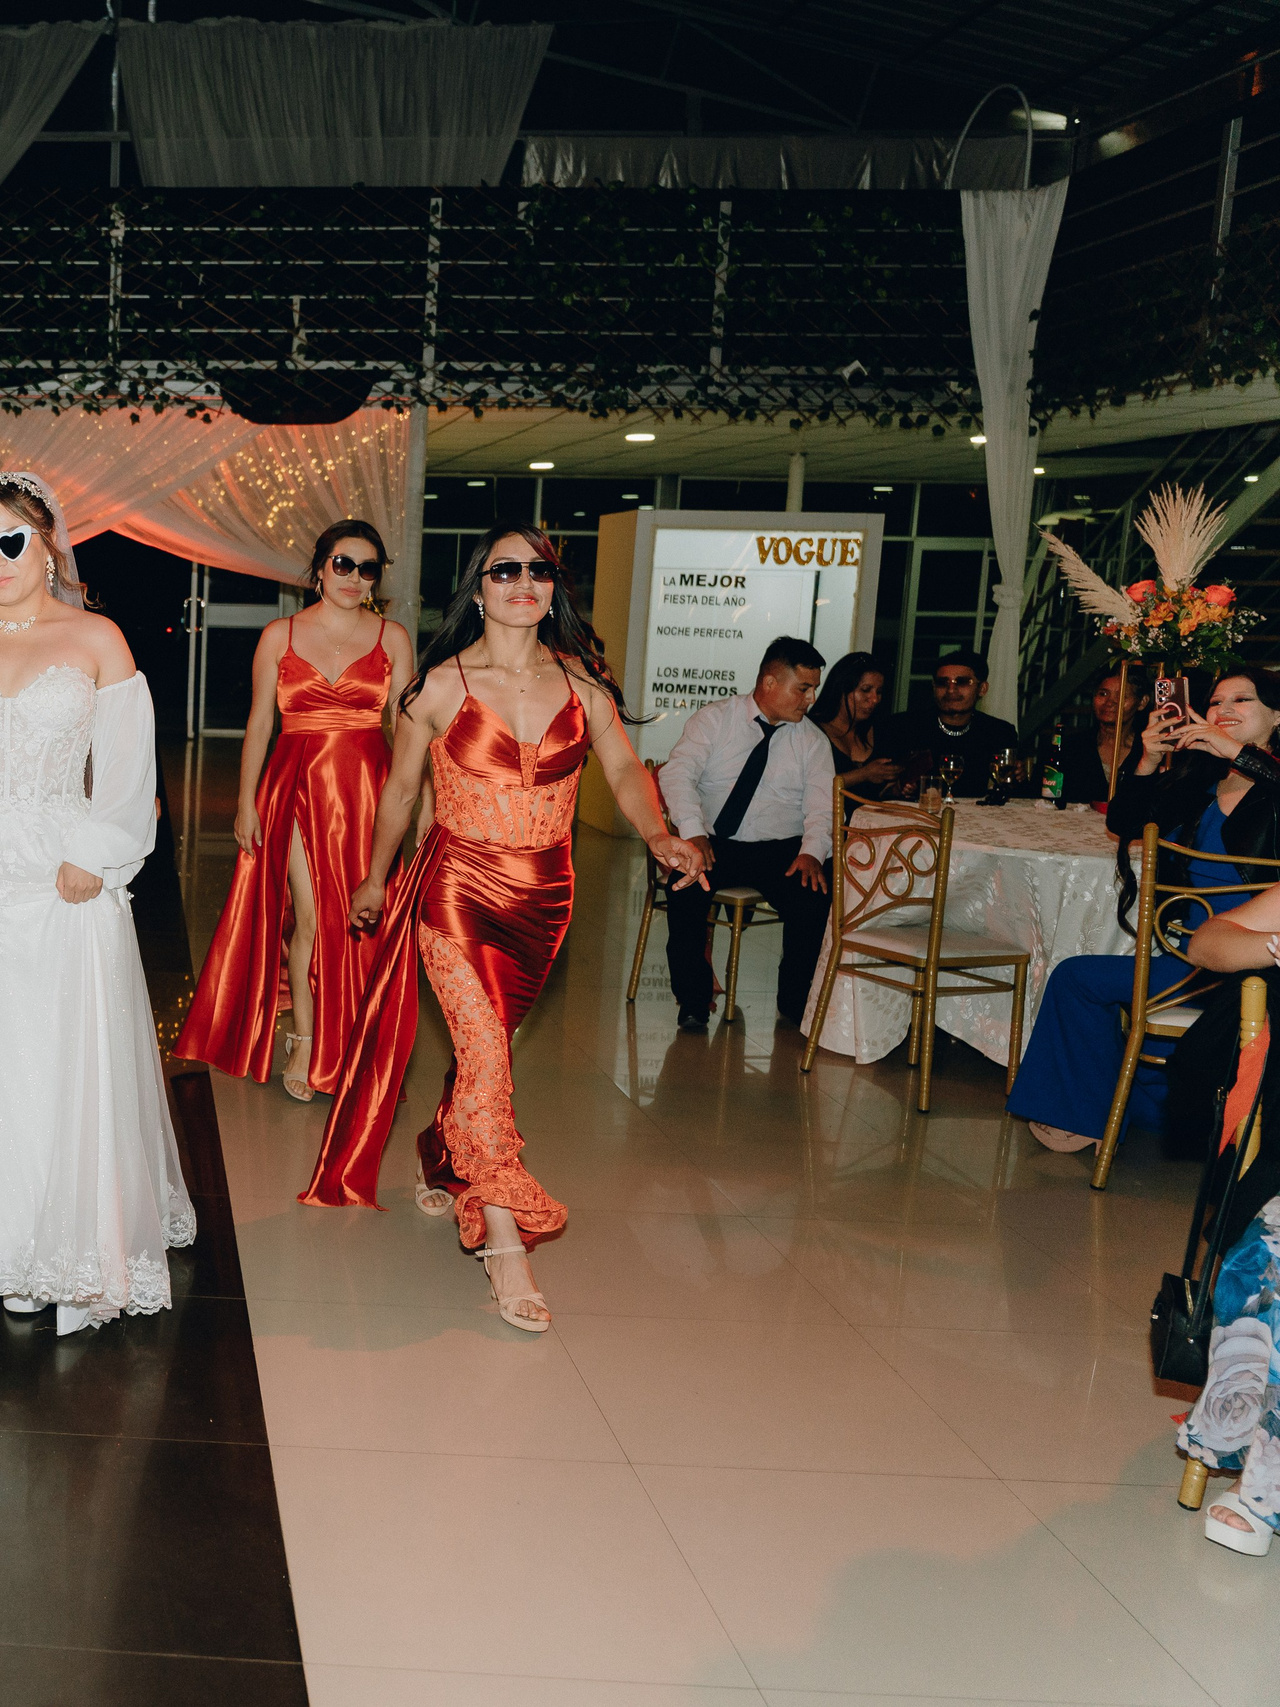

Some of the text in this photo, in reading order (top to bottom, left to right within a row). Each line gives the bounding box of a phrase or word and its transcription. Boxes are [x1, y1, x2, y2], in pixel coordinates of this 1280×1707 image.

[756, 535, 862, 567] VOGUE
[663, 573, 747, 589] LA MEJOR
[663, 594, 746, 607] FIESTA DEL AÑO
[656, 625, 744, 639] NOCHE PERFECTA
[656, 666, 736, 682] LOS MEJORES
[651, 682, 738, 697] MOMENTOS
[655, 697, 670, 708] DE
[672, 698, 687, 709] LA
